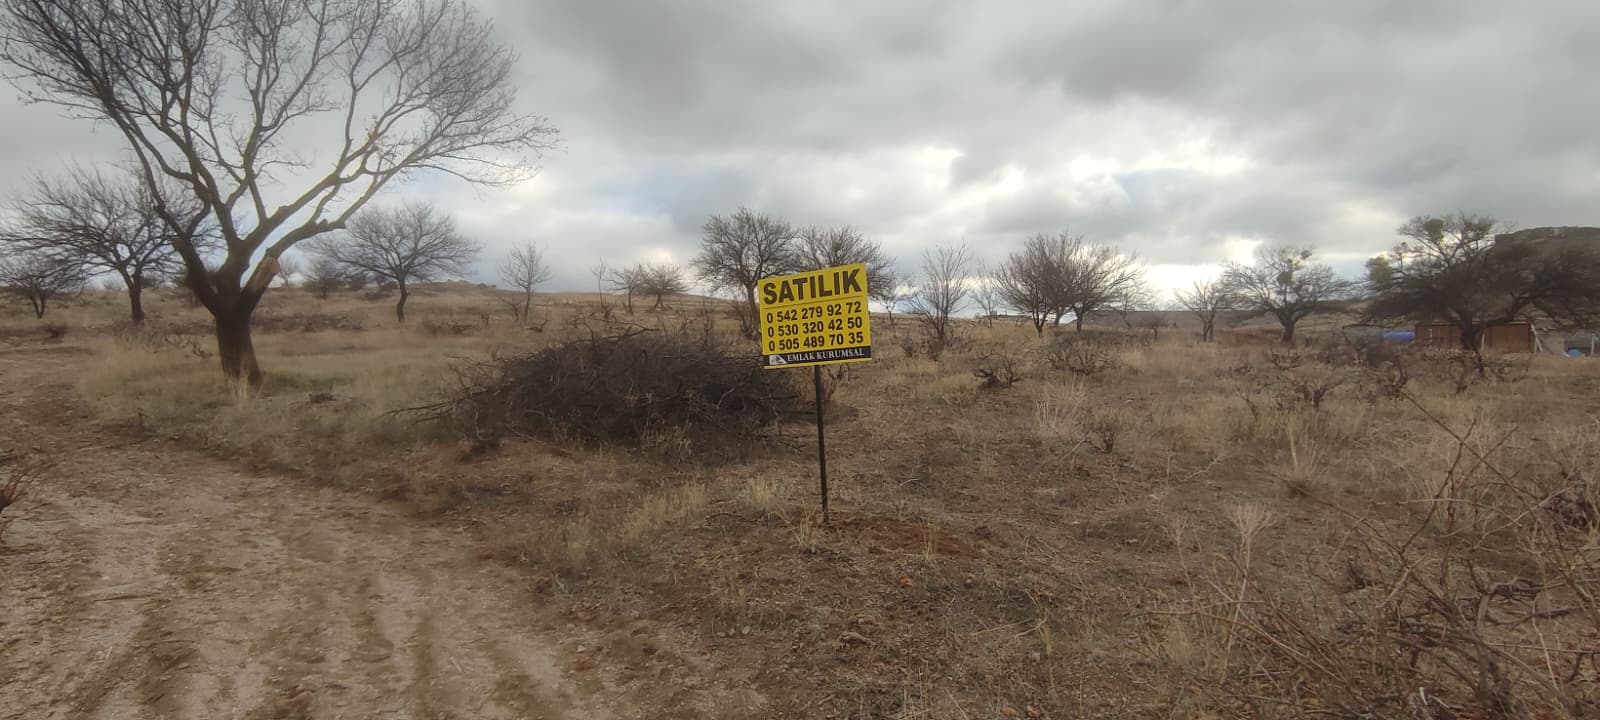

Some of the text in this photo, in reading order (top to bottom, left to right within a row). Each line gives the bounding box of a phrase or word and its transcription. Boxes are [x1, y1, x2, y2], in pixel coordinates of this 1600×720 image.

[763, 269, 862, 305] SATILIK
[766, 301, 861, 324] 0 542 279 92 72
[768, 316, 862, 337] 0 530 320 42 50
[769, 332, 864, 351] 0 505 489 70 35
[788, 348, 864, 362] EMLAK KURUMSAL
